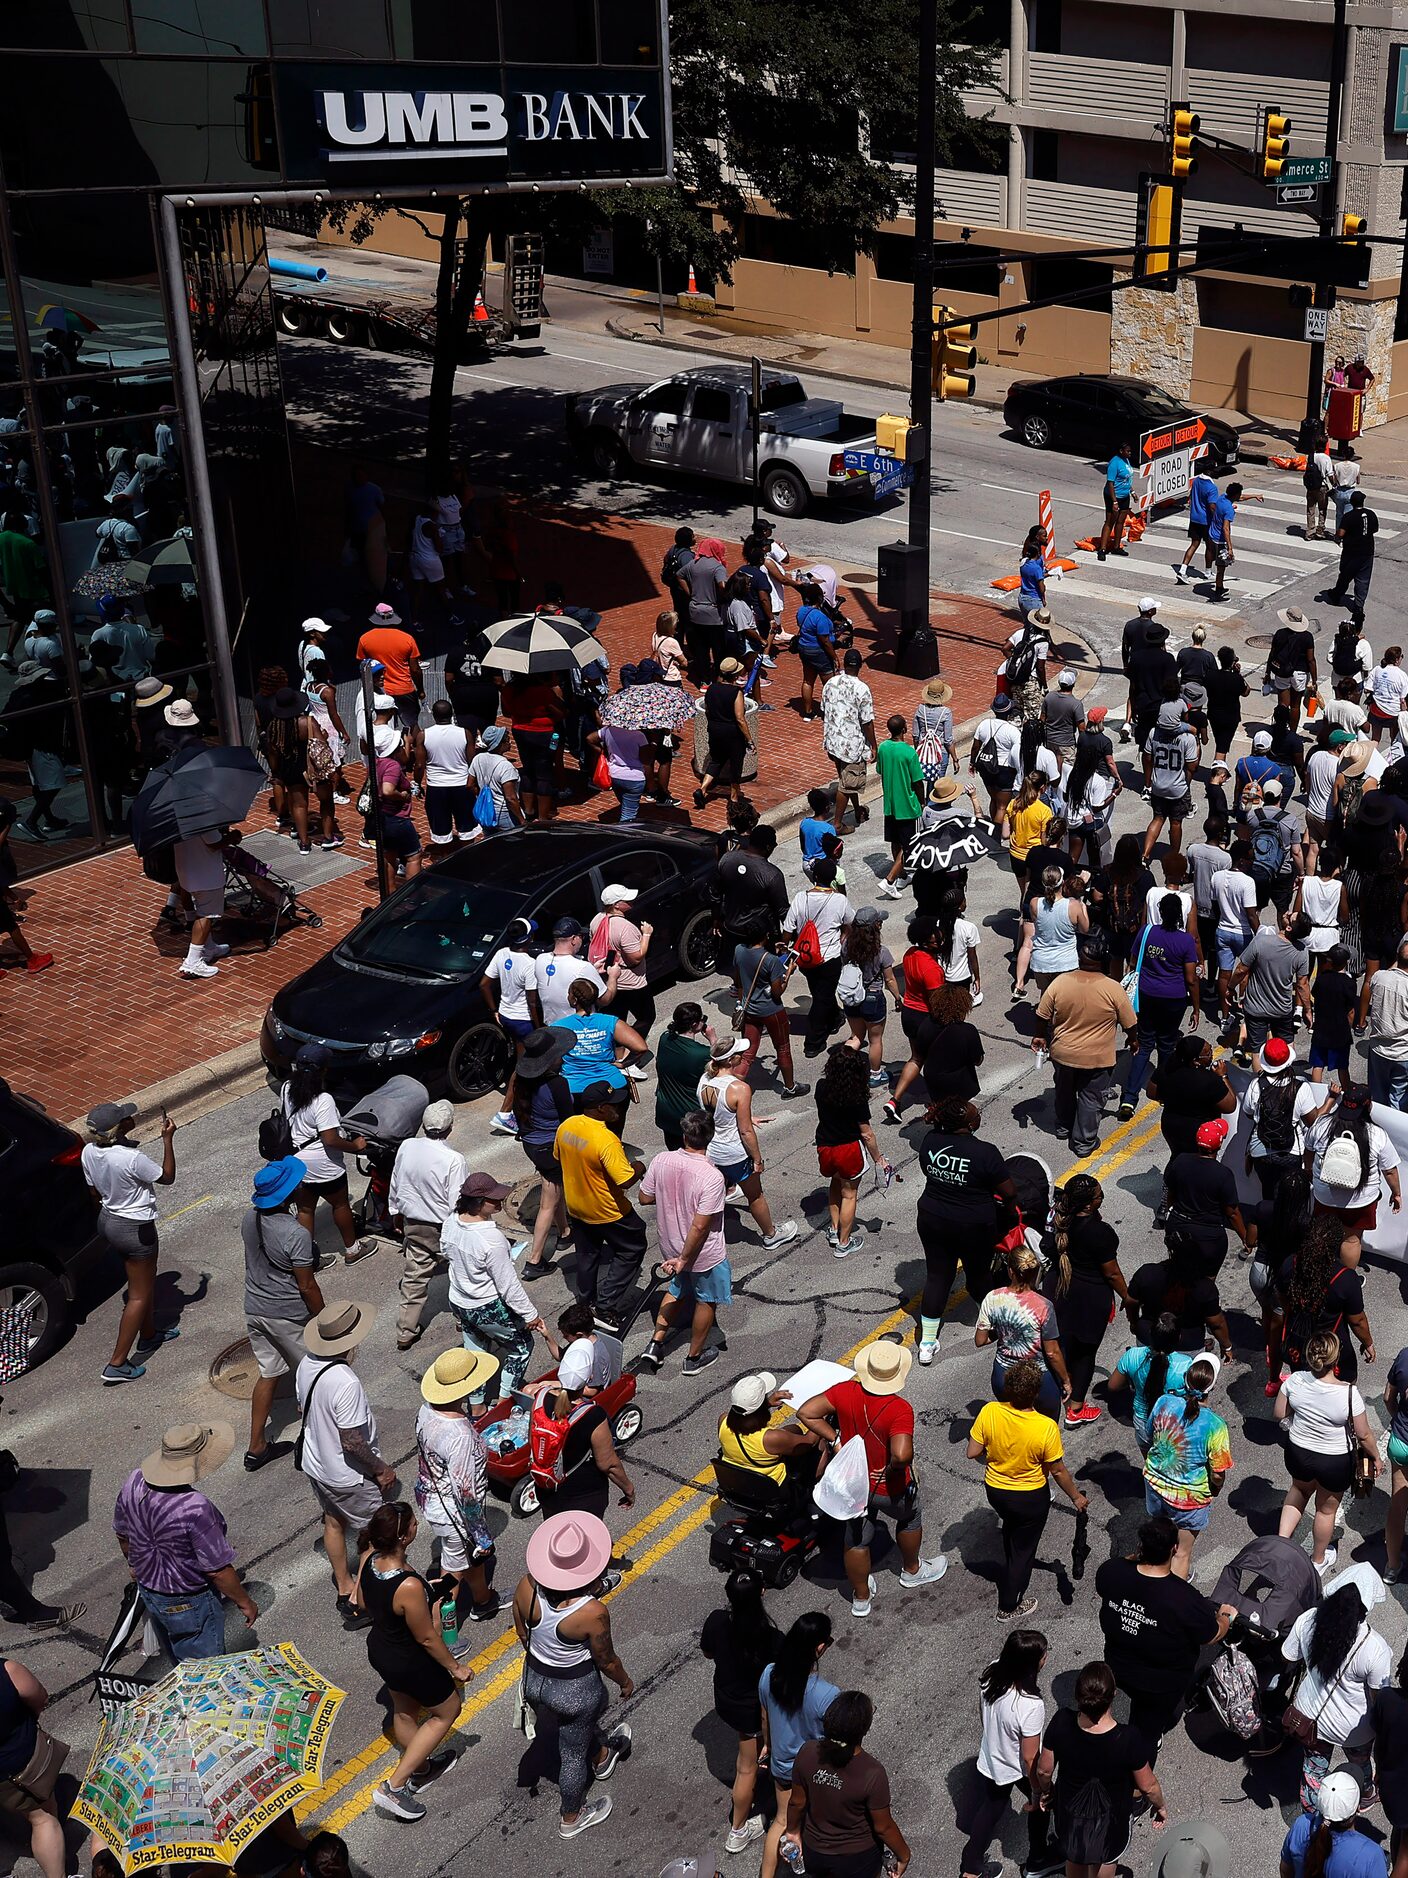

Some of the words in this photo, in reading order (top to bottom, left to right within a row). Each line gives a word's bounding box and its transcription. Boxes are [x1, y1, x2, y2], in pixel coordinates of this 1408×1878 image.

[323, 91, 507, 145] UMB
[525, 92, 649, 141] BANK
[1319, 161, 1328, 173] St
[1307, 320, 1325, 330] WAY
[1308, 311, 1325, 321] ONE
[1150, 434, 1172, 451] DETOUR
[1176, 426, 1198, 444] DETOUR
[654, 441, 672, 449] WATER
[860, 454, 867, 468] E
[873, 457, 893, 471] 6th
[1160, 457, 1182, 475] ROAD
[881, 470, 907, 492] Commerce
[1157, 474, 1187, 495] CLOSED
[460, 661, 481, 677] 40
[1156, 746, 1182, 771] 20
[905, 833, 989, 870] BLACK
[562, 1130, 590, 1152] NAVY
[928, 1145, 971, 1172] VOTE
[926, 1164, 968, 1183] CRYSTAL
[1108, 1600, 1157, 1627] BREASTFEEDING
[1122, 1599, 1145, 1614] BLACK
[1120, 1615, 1141, 1630] WEEK
[1121, 1624, 1138, 1636] 2020
[282, 1646, 331, 1691] Star-Telegram
[304, 1700, 336, 1774] Star-Telegram
[813, 1773, 844, 1787] COFFEE
[228, 1781, 304, 1847] Star-Telegram
[131, 1843, 215, 1866] Star-Telegram
